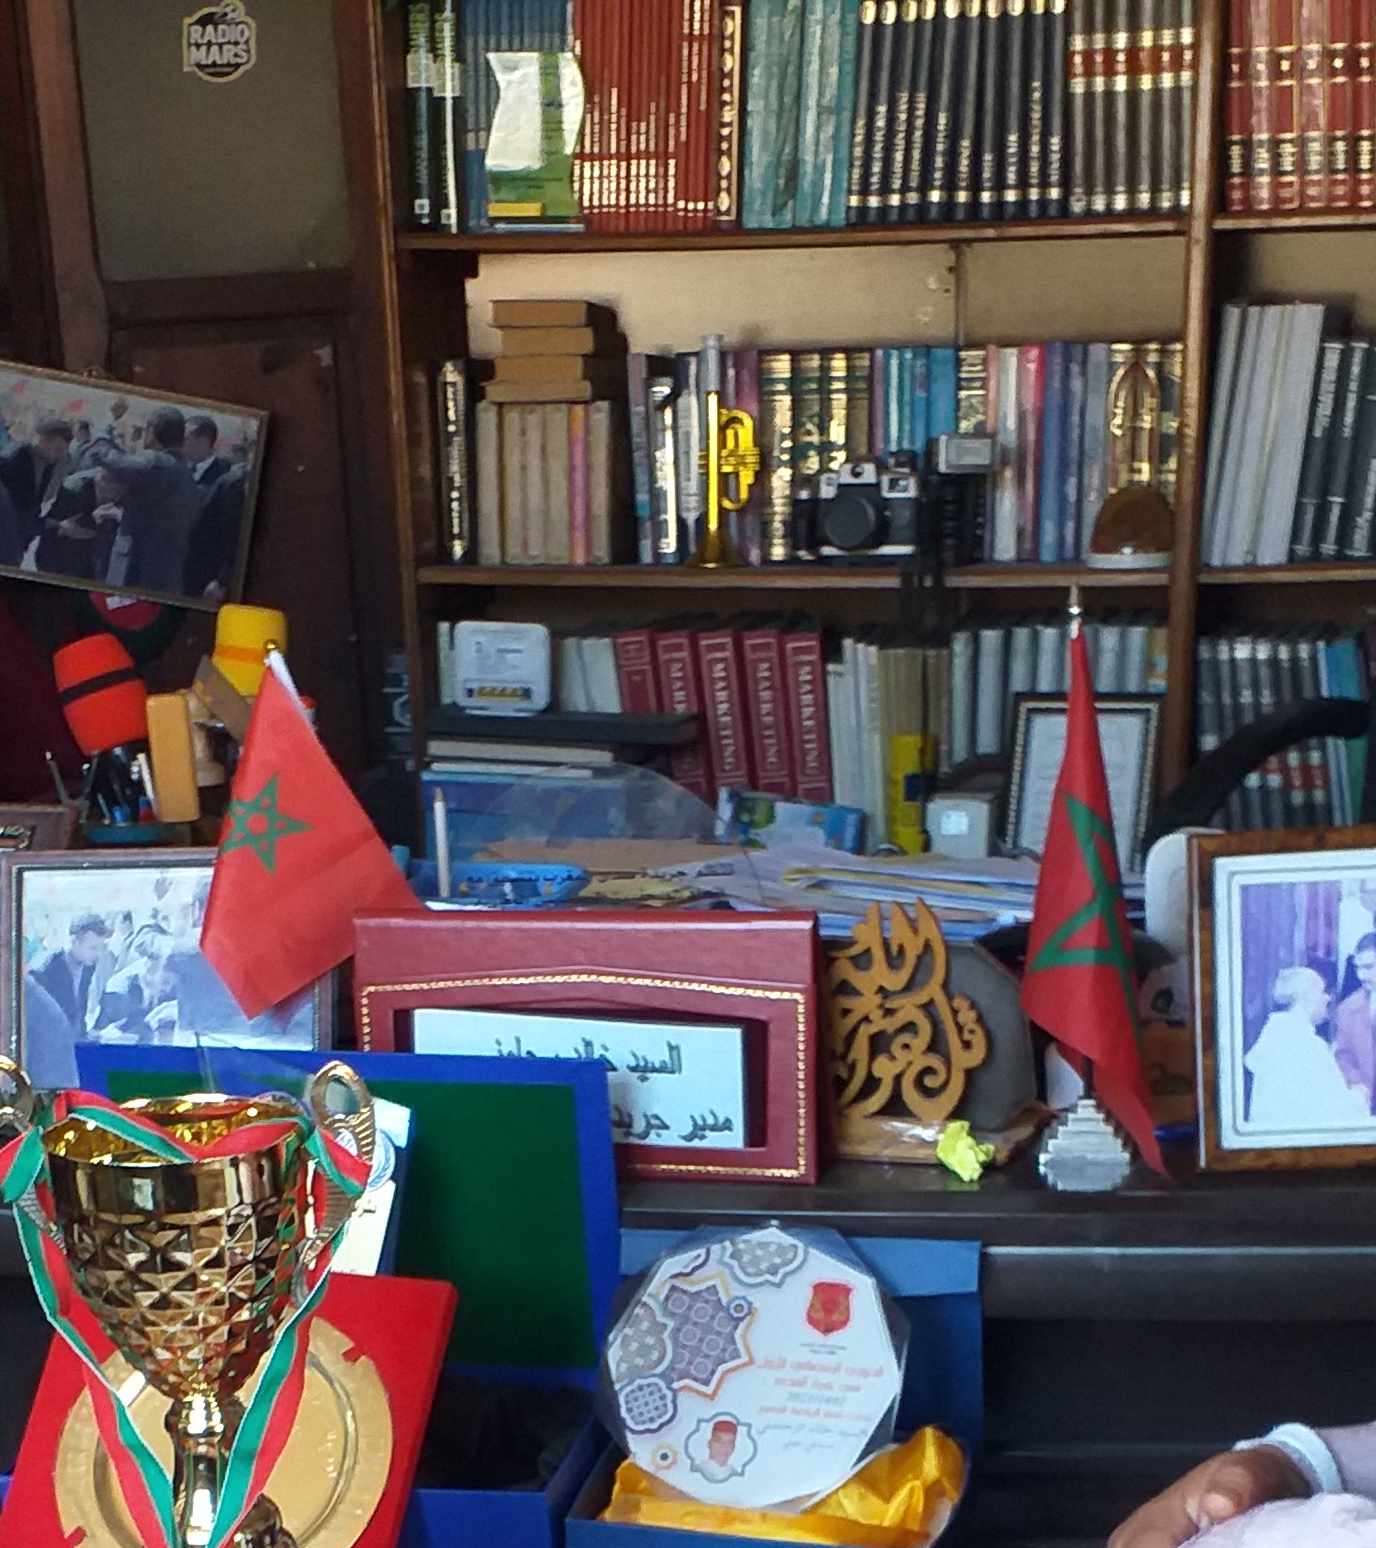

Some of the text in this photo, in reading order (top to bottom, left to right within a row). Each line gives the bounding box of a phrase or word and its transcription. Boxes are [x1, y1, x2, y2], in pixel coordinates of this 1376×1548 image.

[189, 23, 250, 45] RADIO
[190, 44, 248, 66] MARS
[711, 662, 736, 772] MARKETING
[755, 662, 779, 771] MARKETING
[797, 664, 820, 775] MARKETING
[625, 1039, 683, 1083] السيد
[676, 1108, 735, 1143] مدير
